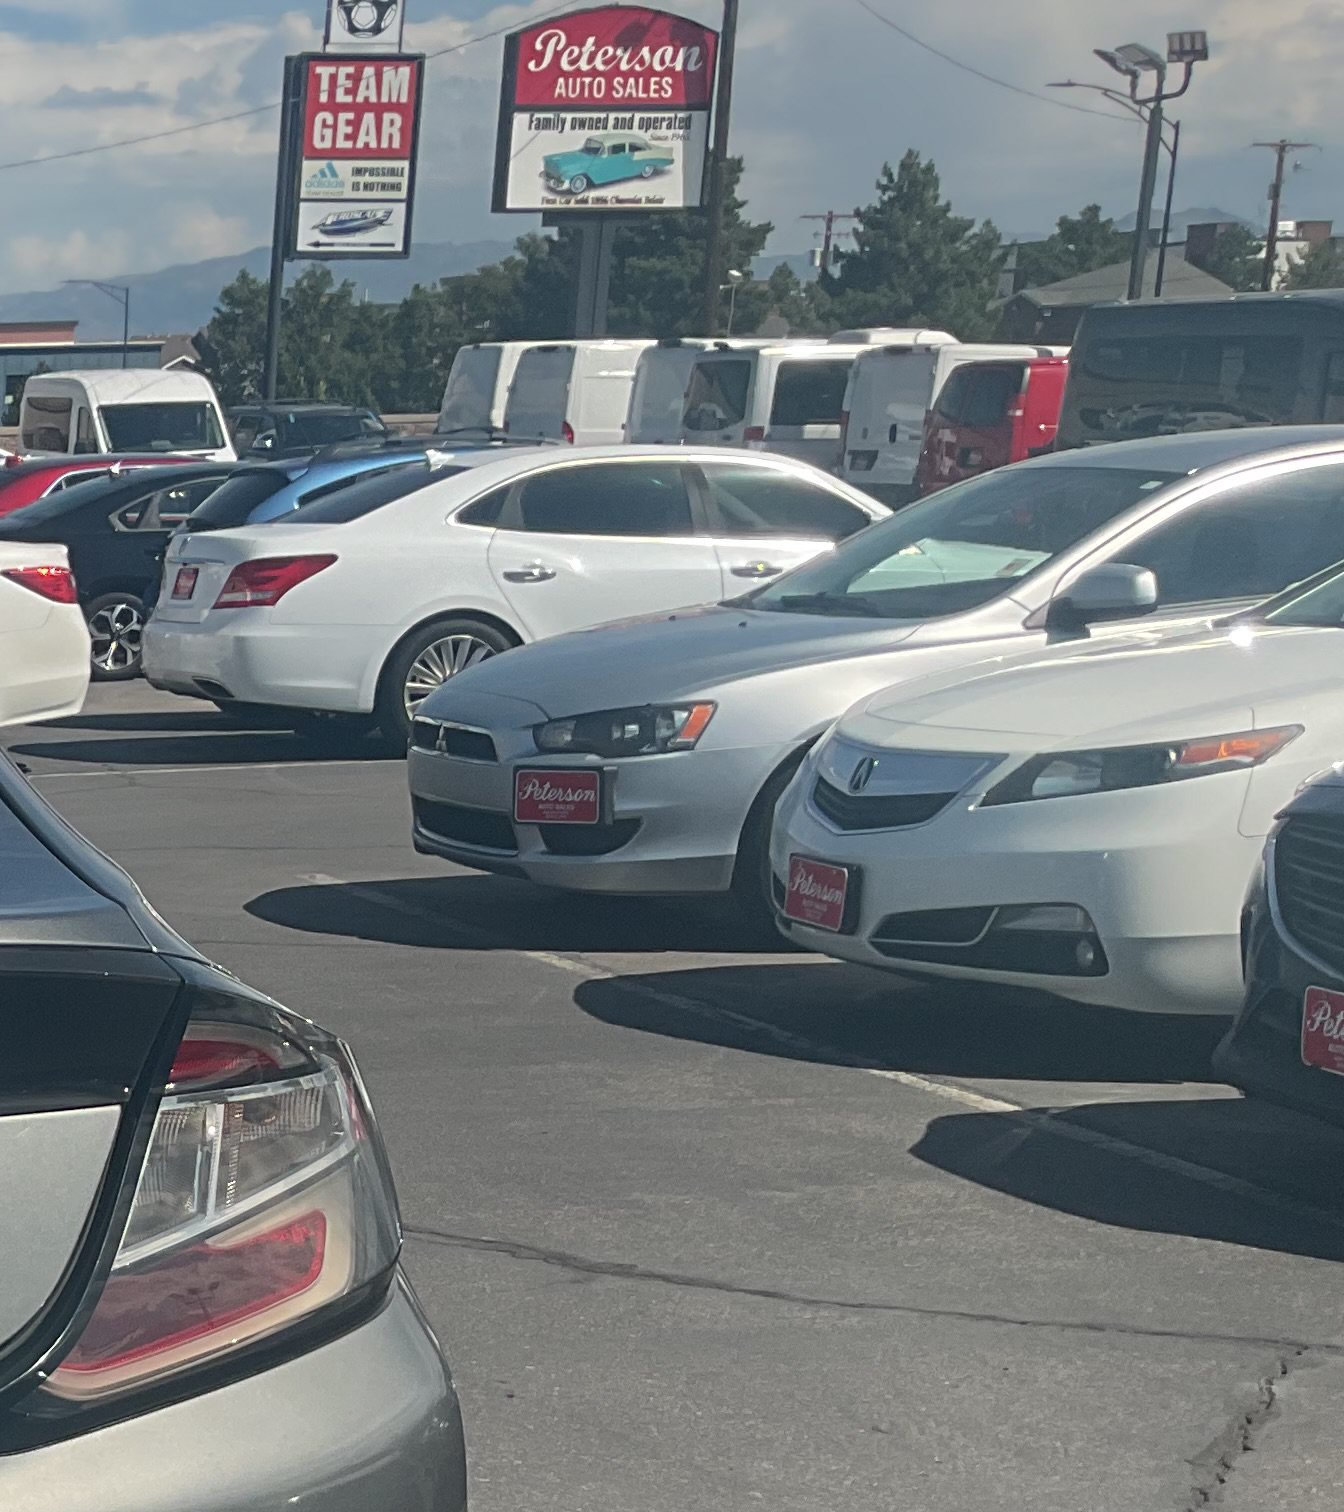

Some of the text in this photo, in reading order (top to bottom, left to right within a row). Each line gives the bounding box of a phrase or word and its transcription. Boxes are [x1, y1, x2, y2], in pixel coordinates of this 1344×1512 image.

[528, 29, 703, 72] Peterson
[315, 66, 410, 103] TEAM
[554, 77, 673, 98] AUTO SALES
[313, 111, 402, 149] GEAR
[528, 113, 692, 133] Family owned and operated
[305, 176, 345, 188] adidas
[352, 166, 405, 177] IMPOSSIBLE
[352, 181, 402, 192] IS NOTHING
[519, 778, 596, 802] Peterson
[790, 867, 843, 905] Peterson
